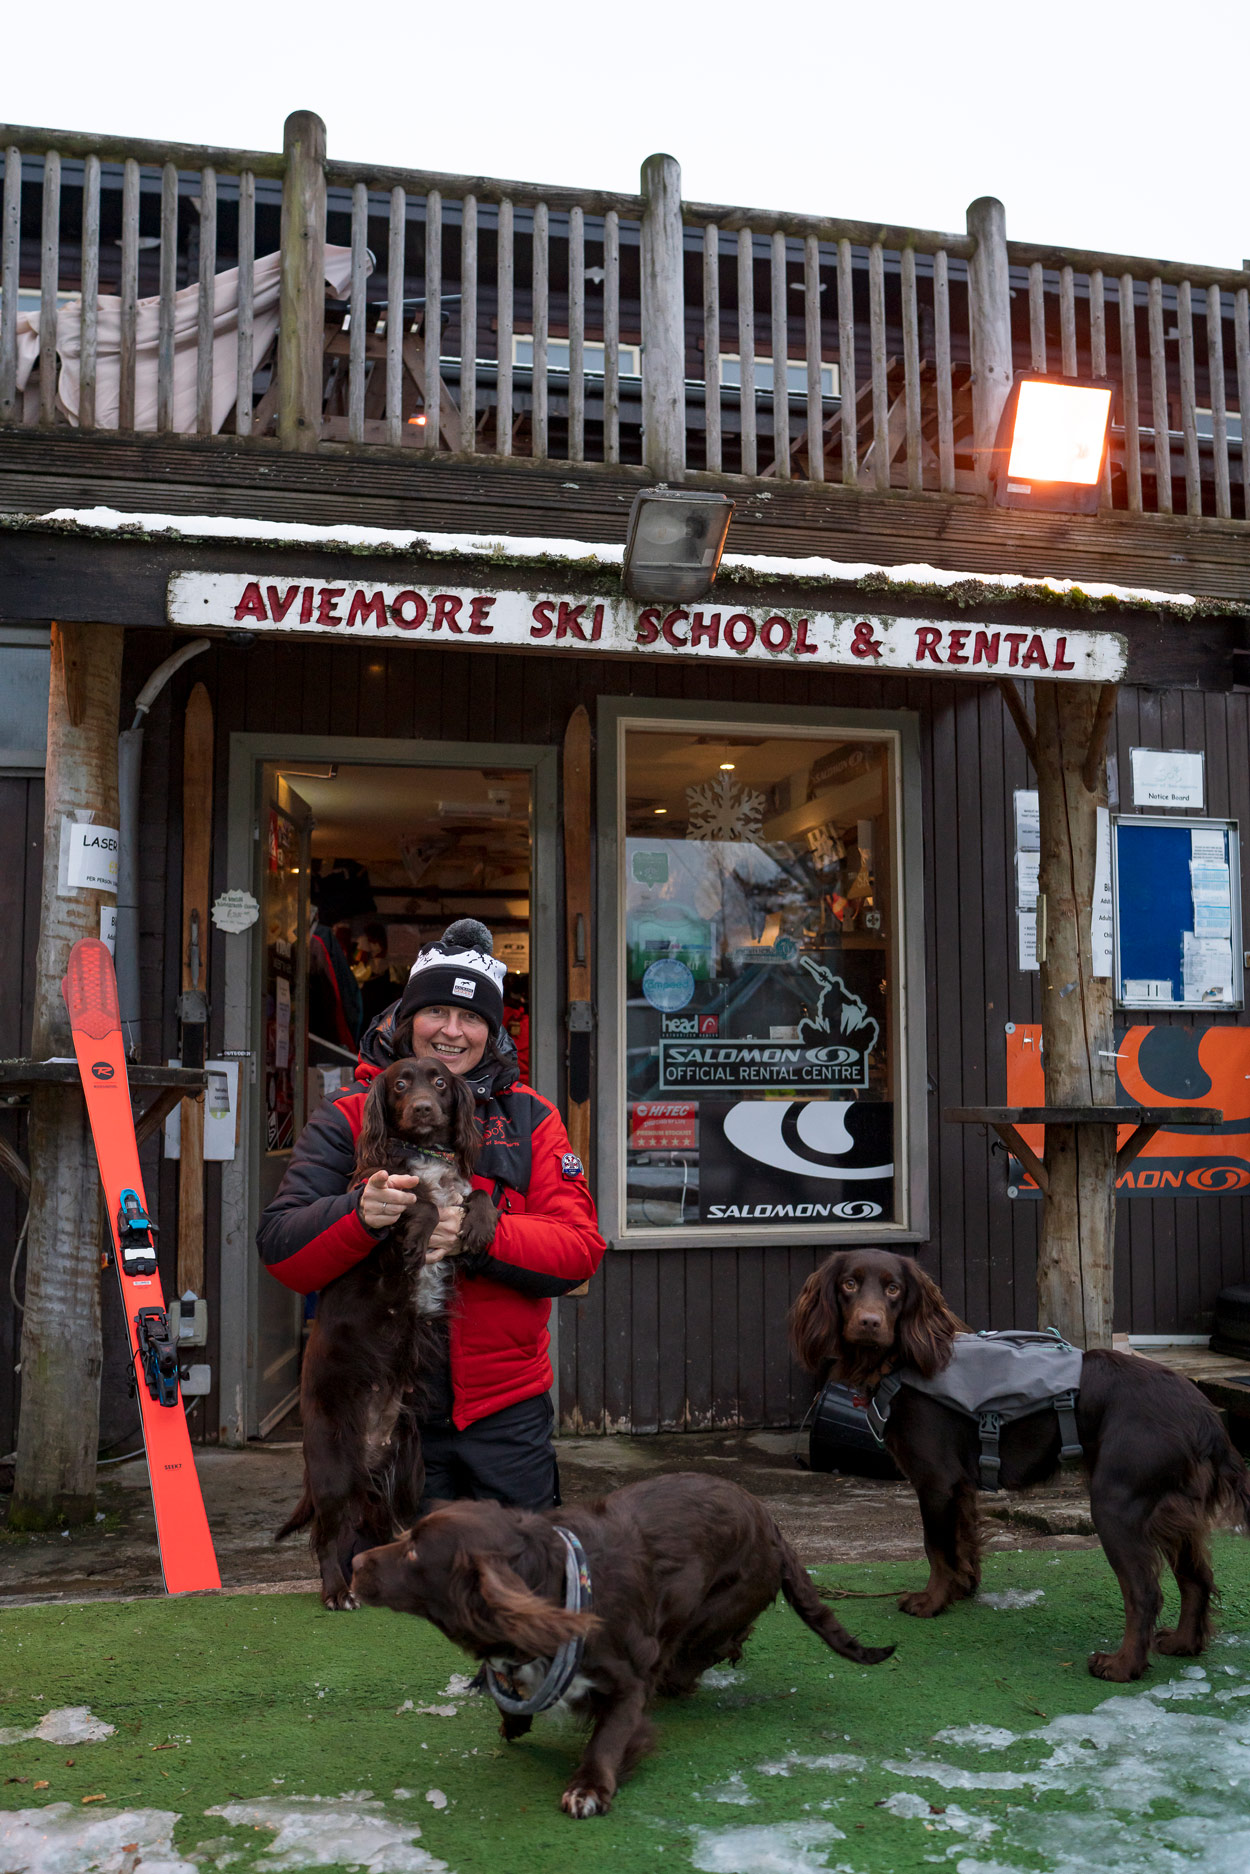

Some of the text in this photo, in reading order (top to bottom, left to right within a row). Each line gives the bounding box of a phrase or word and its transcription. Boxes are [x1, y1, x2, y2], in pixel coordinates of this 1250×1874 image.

[234, 582, 1075, 671] AVIEMORE SKI SCHOOL & RENTAL
[662, 1013, 698, 1033] head
[666, 1048, 800, 1062] SALOMON
[666, 1066, 861, 1080] OFFICIAL RENTAL CENTRE
[707, 1203, 832, 1218] SALOMON
